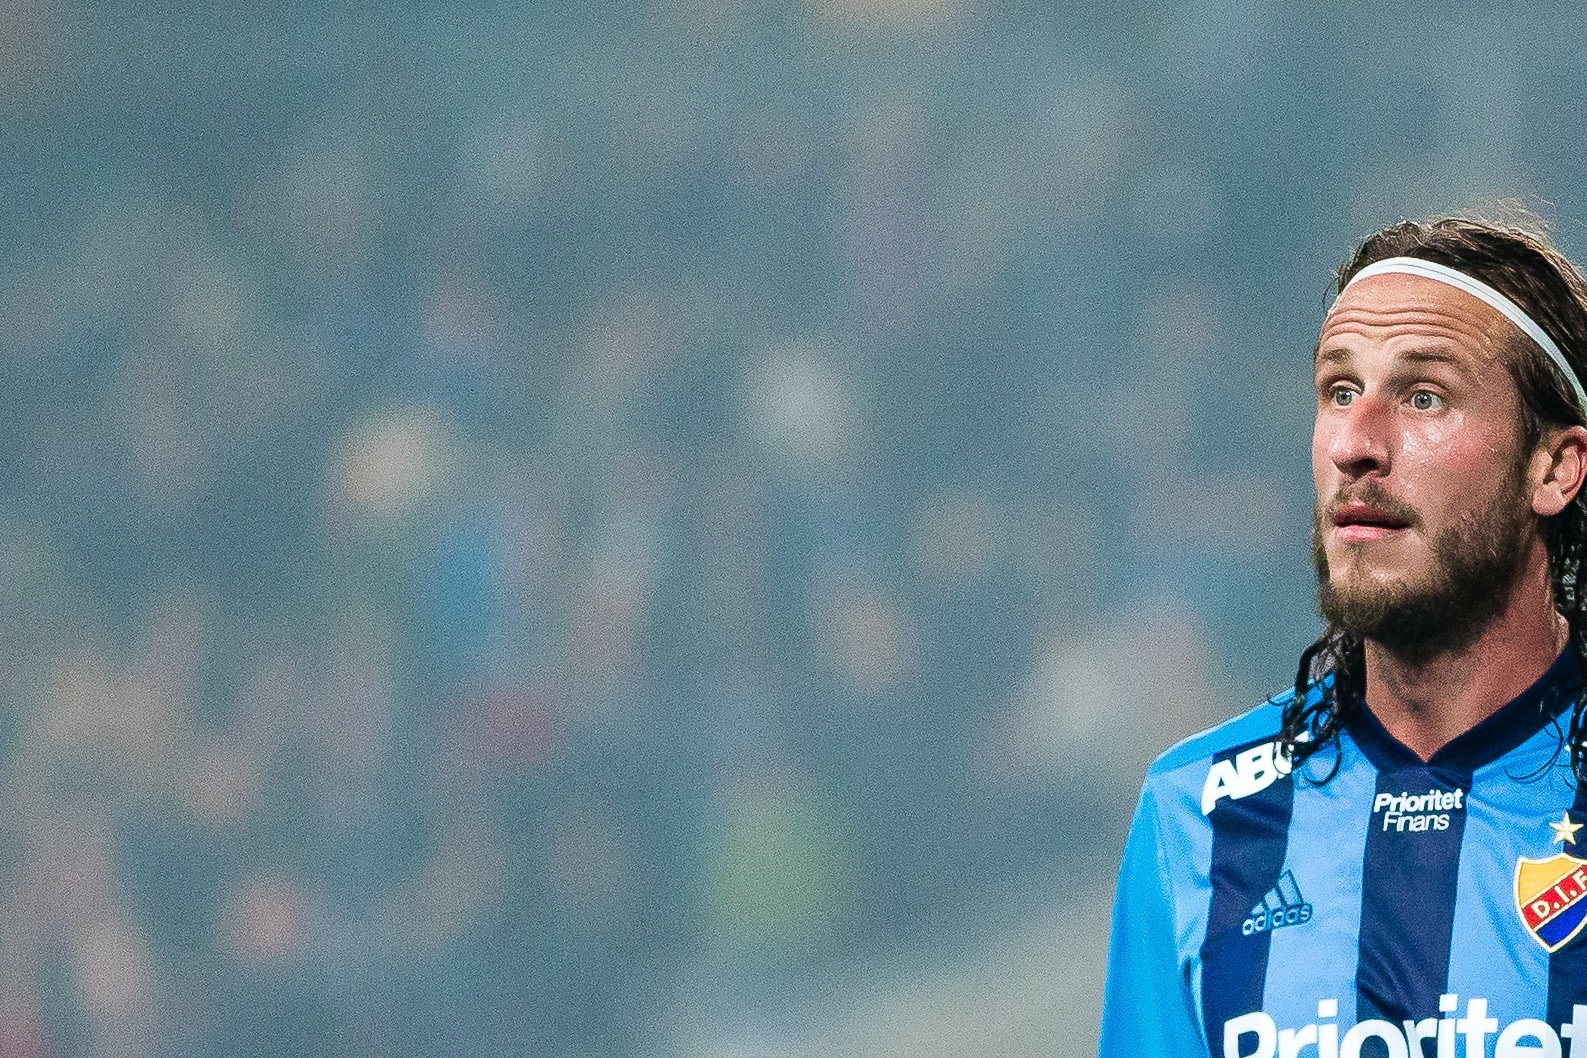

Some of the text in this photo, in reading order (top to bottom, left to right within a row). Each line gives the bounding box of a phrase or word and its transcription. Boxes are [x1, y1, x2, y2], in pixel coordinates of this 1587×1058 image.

[1373, 788, 1463, 813] Prioritet
[1382, 811, 1450, 832] Finans
[1242, 903, 1313, 936] adidas
